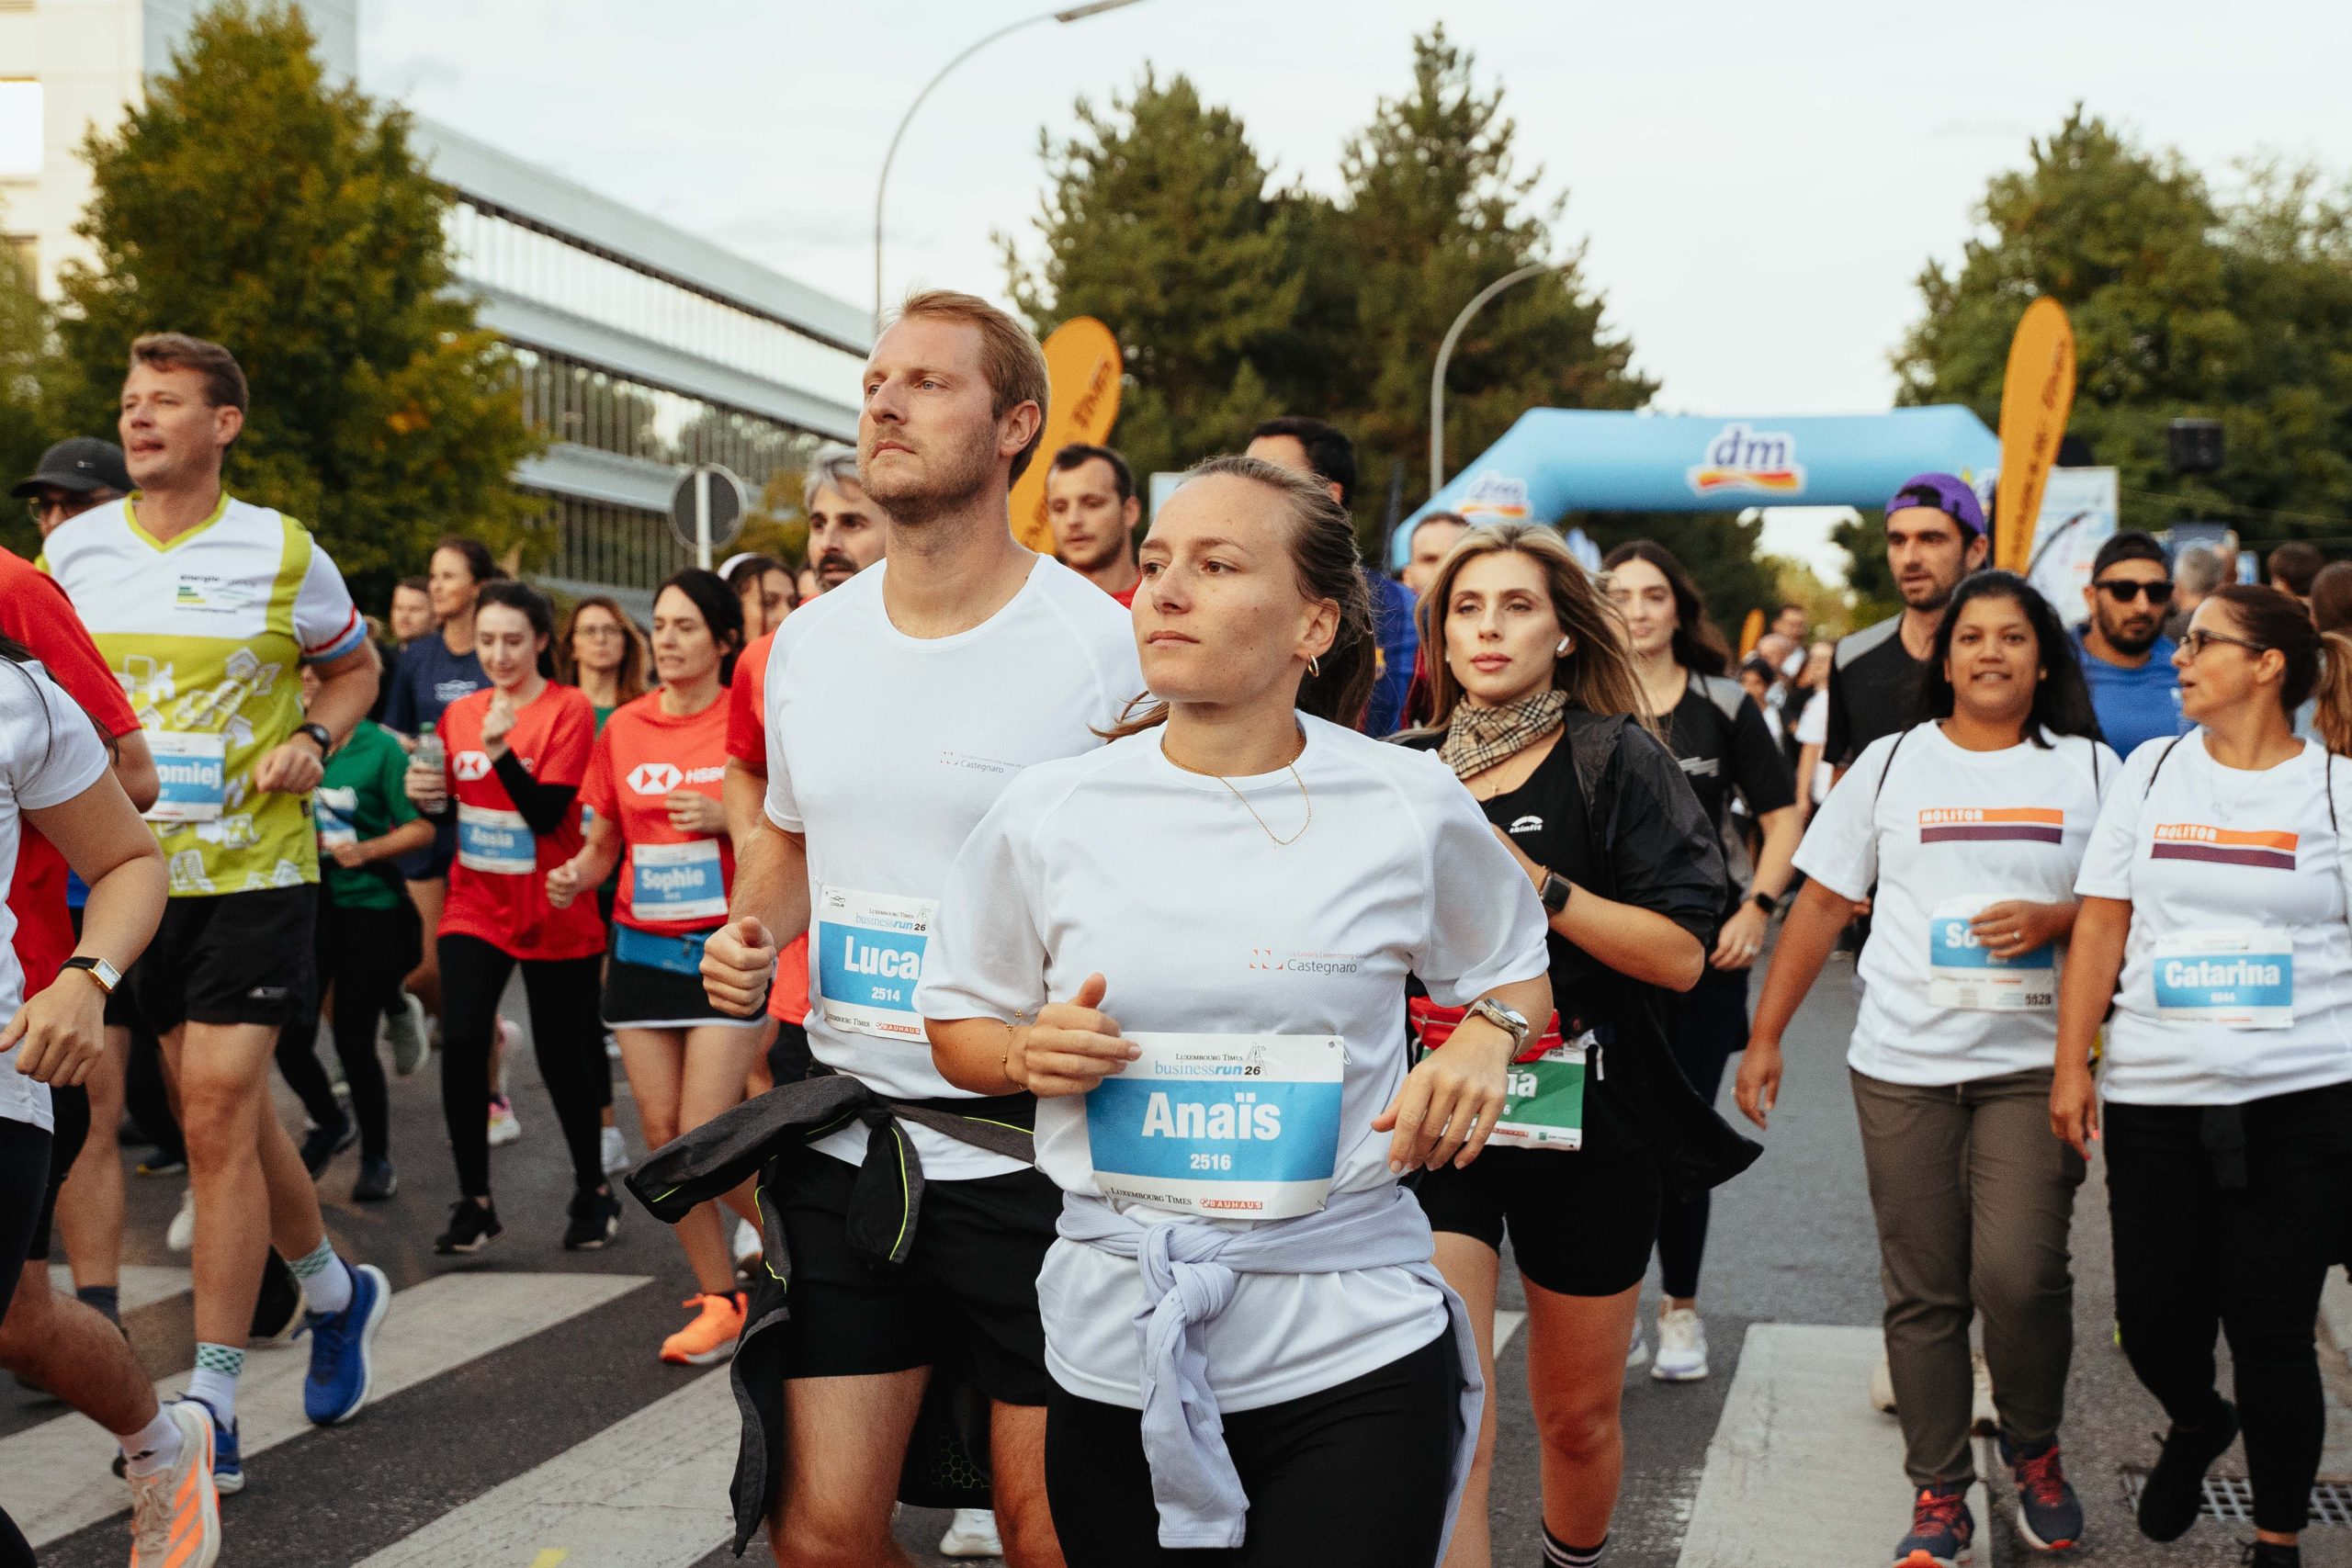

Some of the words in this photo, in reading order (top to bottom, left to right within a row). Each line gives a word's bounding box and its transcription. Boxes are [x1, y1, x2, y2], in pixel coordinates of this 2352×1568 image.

[1714, 429, 1786, 468] dm
[960, 759, 1004, 773] Castegnaro
[1921, 809, 1984, 823] MOLITOR
[2157, 825, 2217, 840] MOLITOR
[641, 866, 706, 894] Sophie
[913, 922, 926, 931] 26
[843, 934, 920, 980] Luca
[1287, 958, 1358, 976] Castegnaro
[2165, 958, 2281, 988] Catarina
[871, 986, 900, 1002] 2514
[853, 1017, 871, 1028] TIMES
[882, 1022, 921, 1034] BAUHAUS
[1175, 1053, 1221, 1062] LUXEMBOURG
[1222, 1054, 1244, 1062] TIMES
[1244, 1066, 1261, 1076] 26
[1141, 1091, 1282, 1141] Anaïs
[1190, 1153, 1232, 1171] 2516
[1110, 1187, 1165, 1203] LUXEMBOURG
[1165, 1194, 1193, 1206] TIMES
[1209, 1200, 1263, 1211] BAUHAUS
